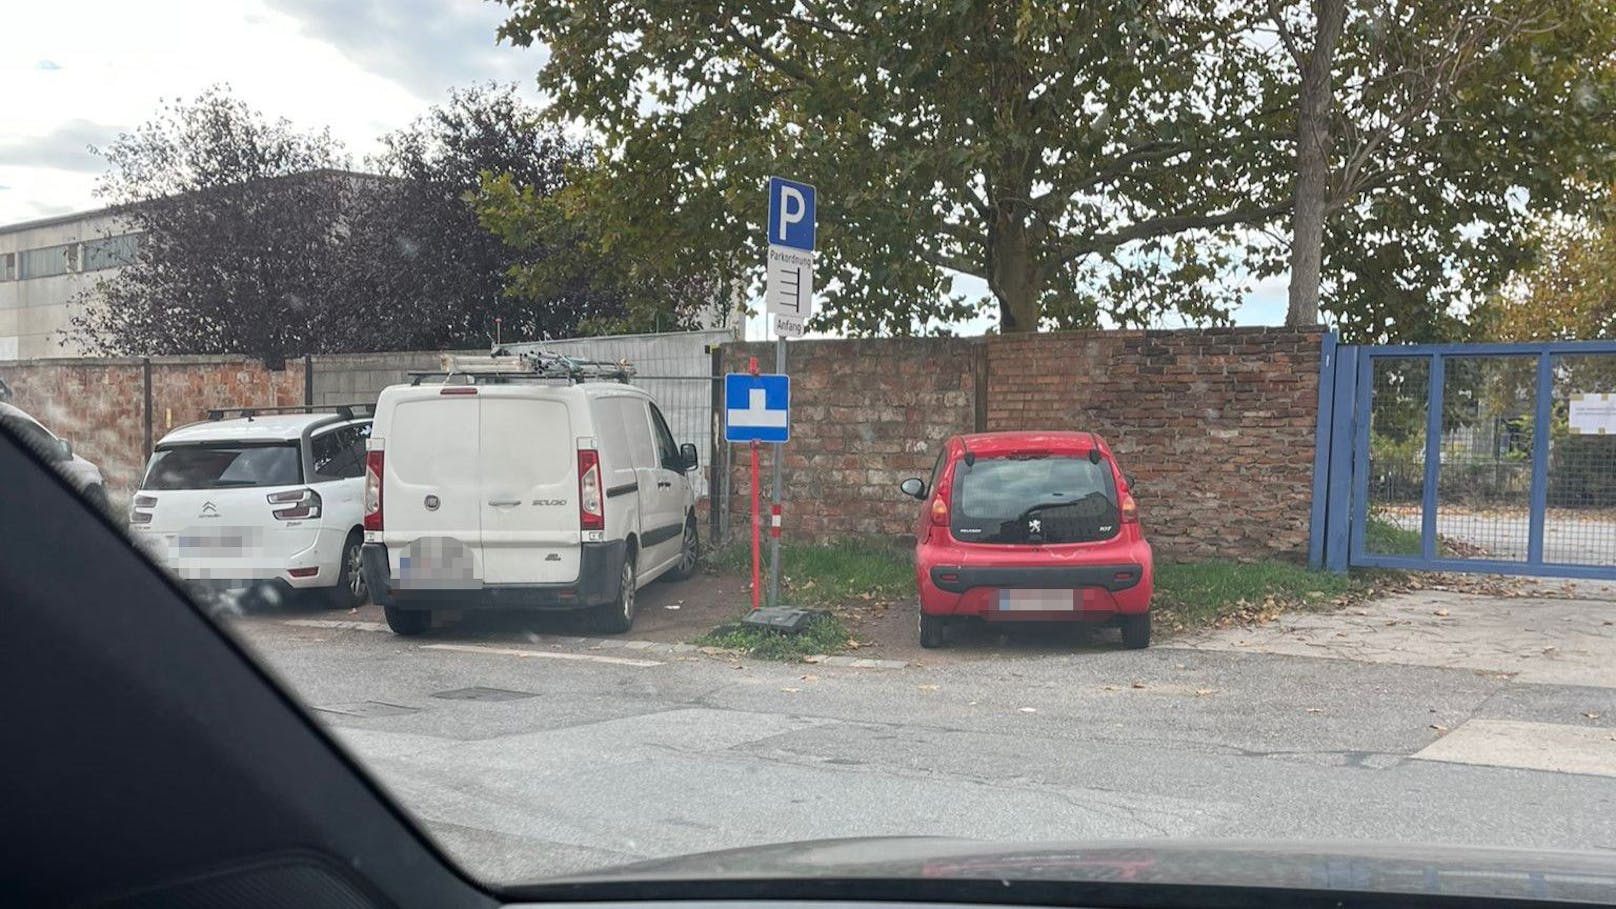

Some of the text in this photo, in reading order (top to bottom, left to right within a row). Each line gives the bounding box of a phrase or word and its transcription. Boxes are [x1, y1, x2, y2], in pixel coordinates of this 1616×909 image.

[779, 185, 806, 241] P
[769, 249, 812, 269] Parkordnung
[776, 319, 802, 336] Anfang
